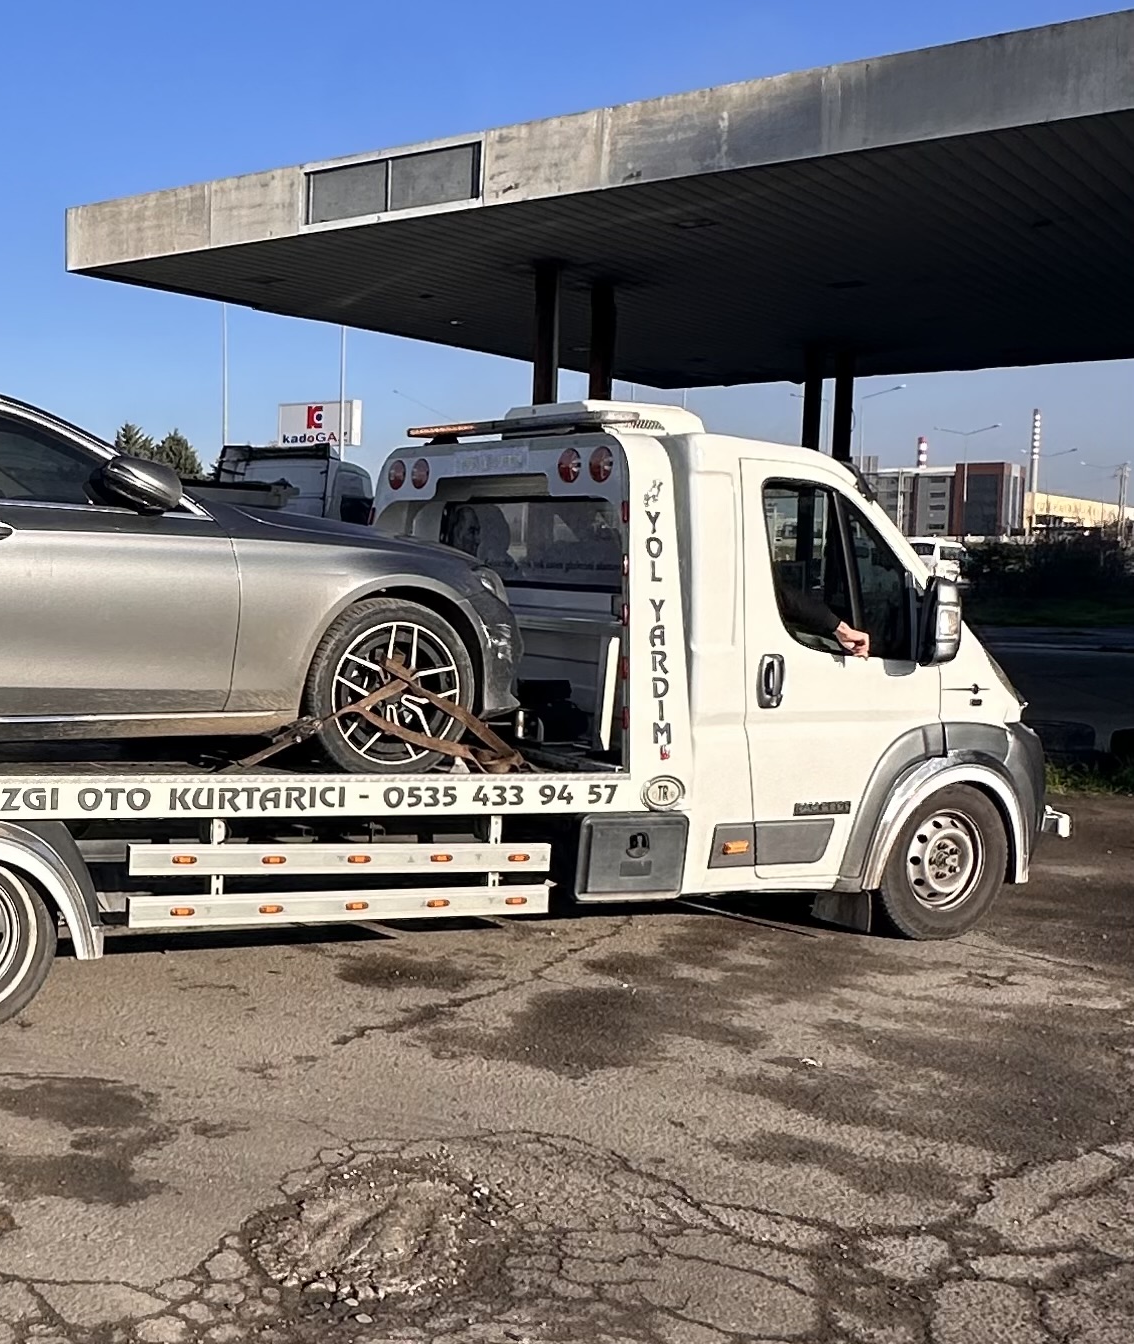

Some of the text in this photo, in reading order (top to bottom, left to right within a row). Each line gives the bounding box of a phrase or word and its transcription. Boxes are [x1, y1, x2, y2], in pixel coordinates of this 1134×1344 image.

[644, 510, 672, 745] YOL YARDIM
[77, 787, 152, 812] OTO
[168, 786, 346, 813] KURTARICI
[382, 785, 458, 809] 0535
[471, 785, 524, 807] 433
[538, 784, 574, 806] 94
[587, 783, 619, 805] 57
[657, 784, 669, 802] TR
